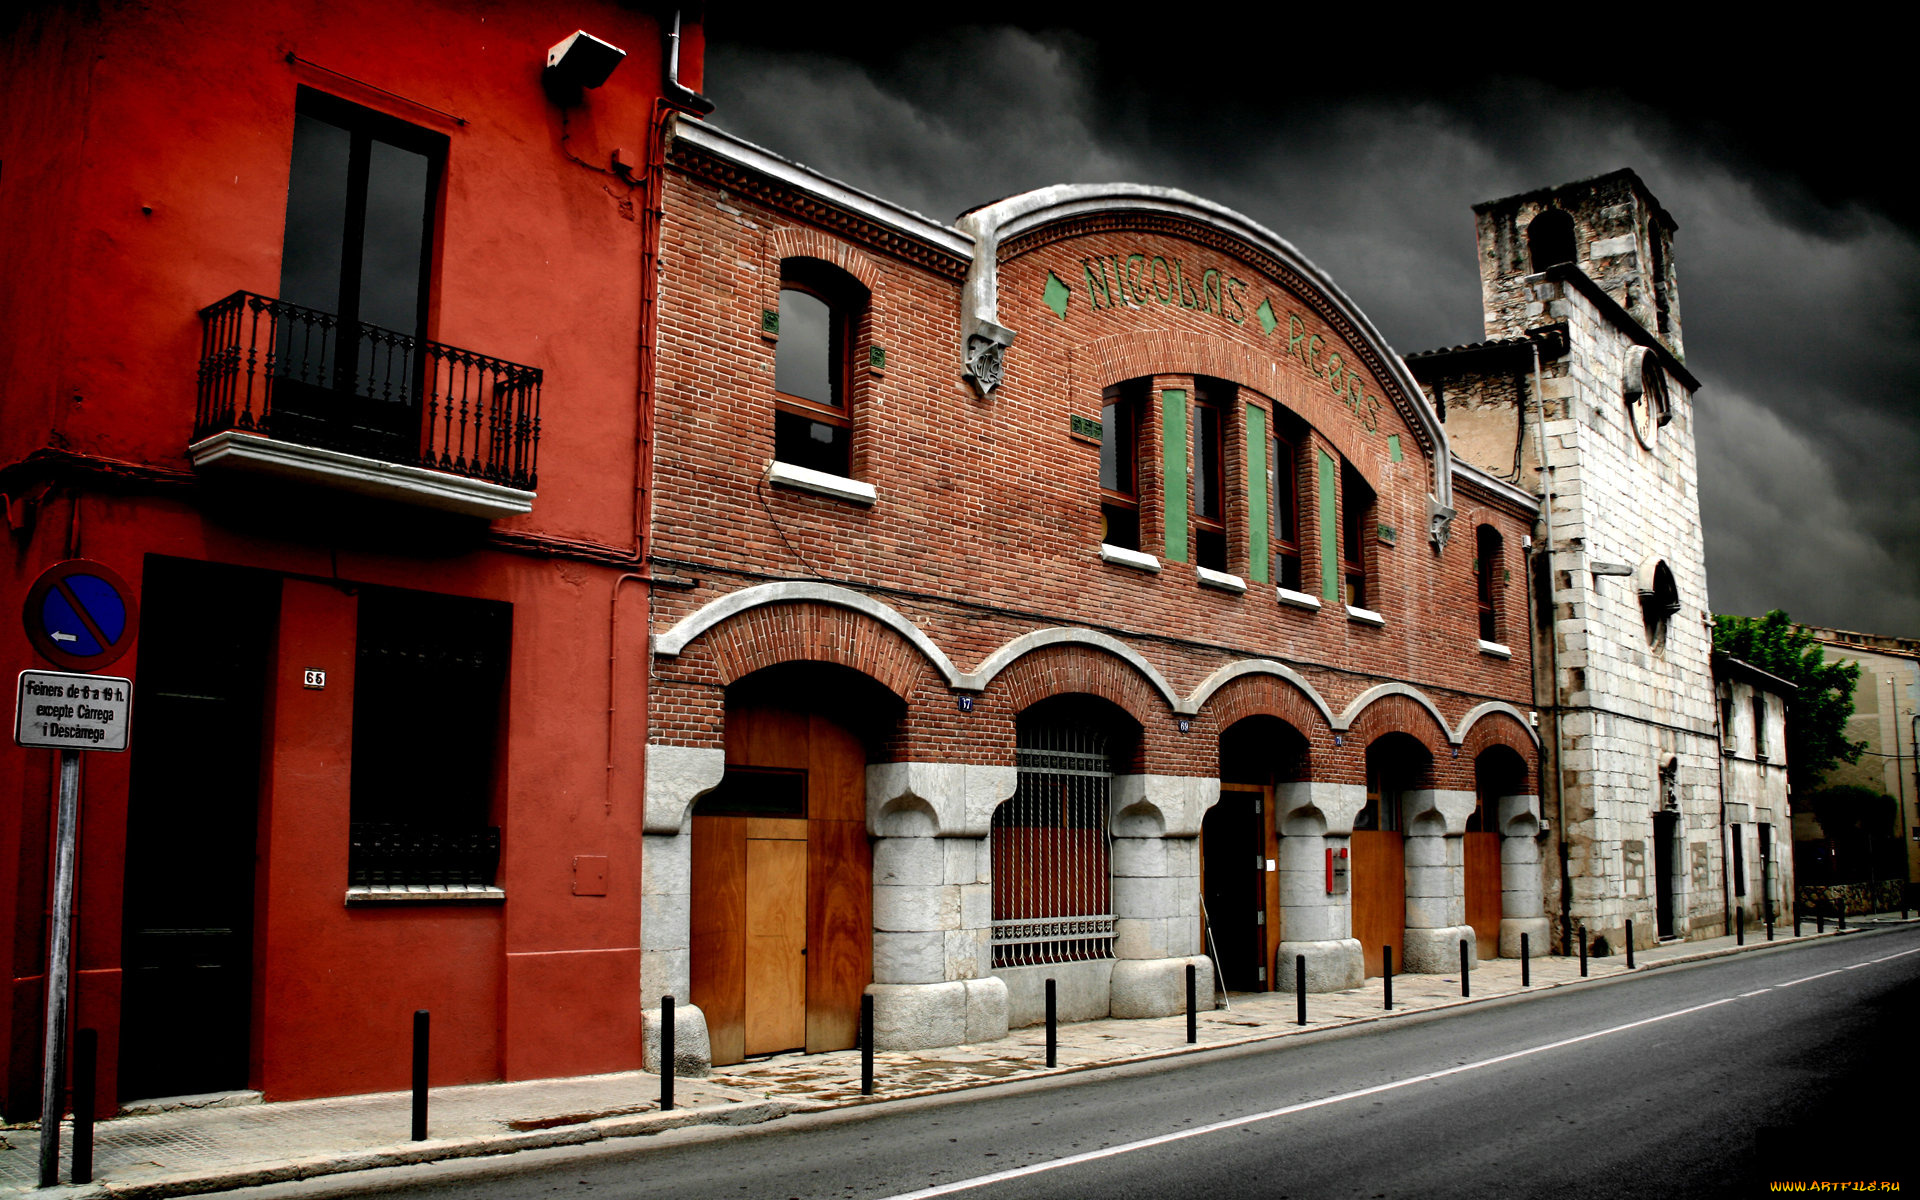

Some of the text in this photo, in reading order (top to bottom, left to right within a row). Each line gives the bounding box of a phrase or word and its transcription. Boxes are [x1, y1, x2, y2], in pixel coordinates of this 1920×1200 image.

[1080, 253, 1383, 435] NICOLAS REGAS
[26, 680, 124, 702] Feiners de 8 a 19 h.
[36, 704, 114, 724] excepte Càrrega
[43, 722, 105, 743] i Descàrrega
